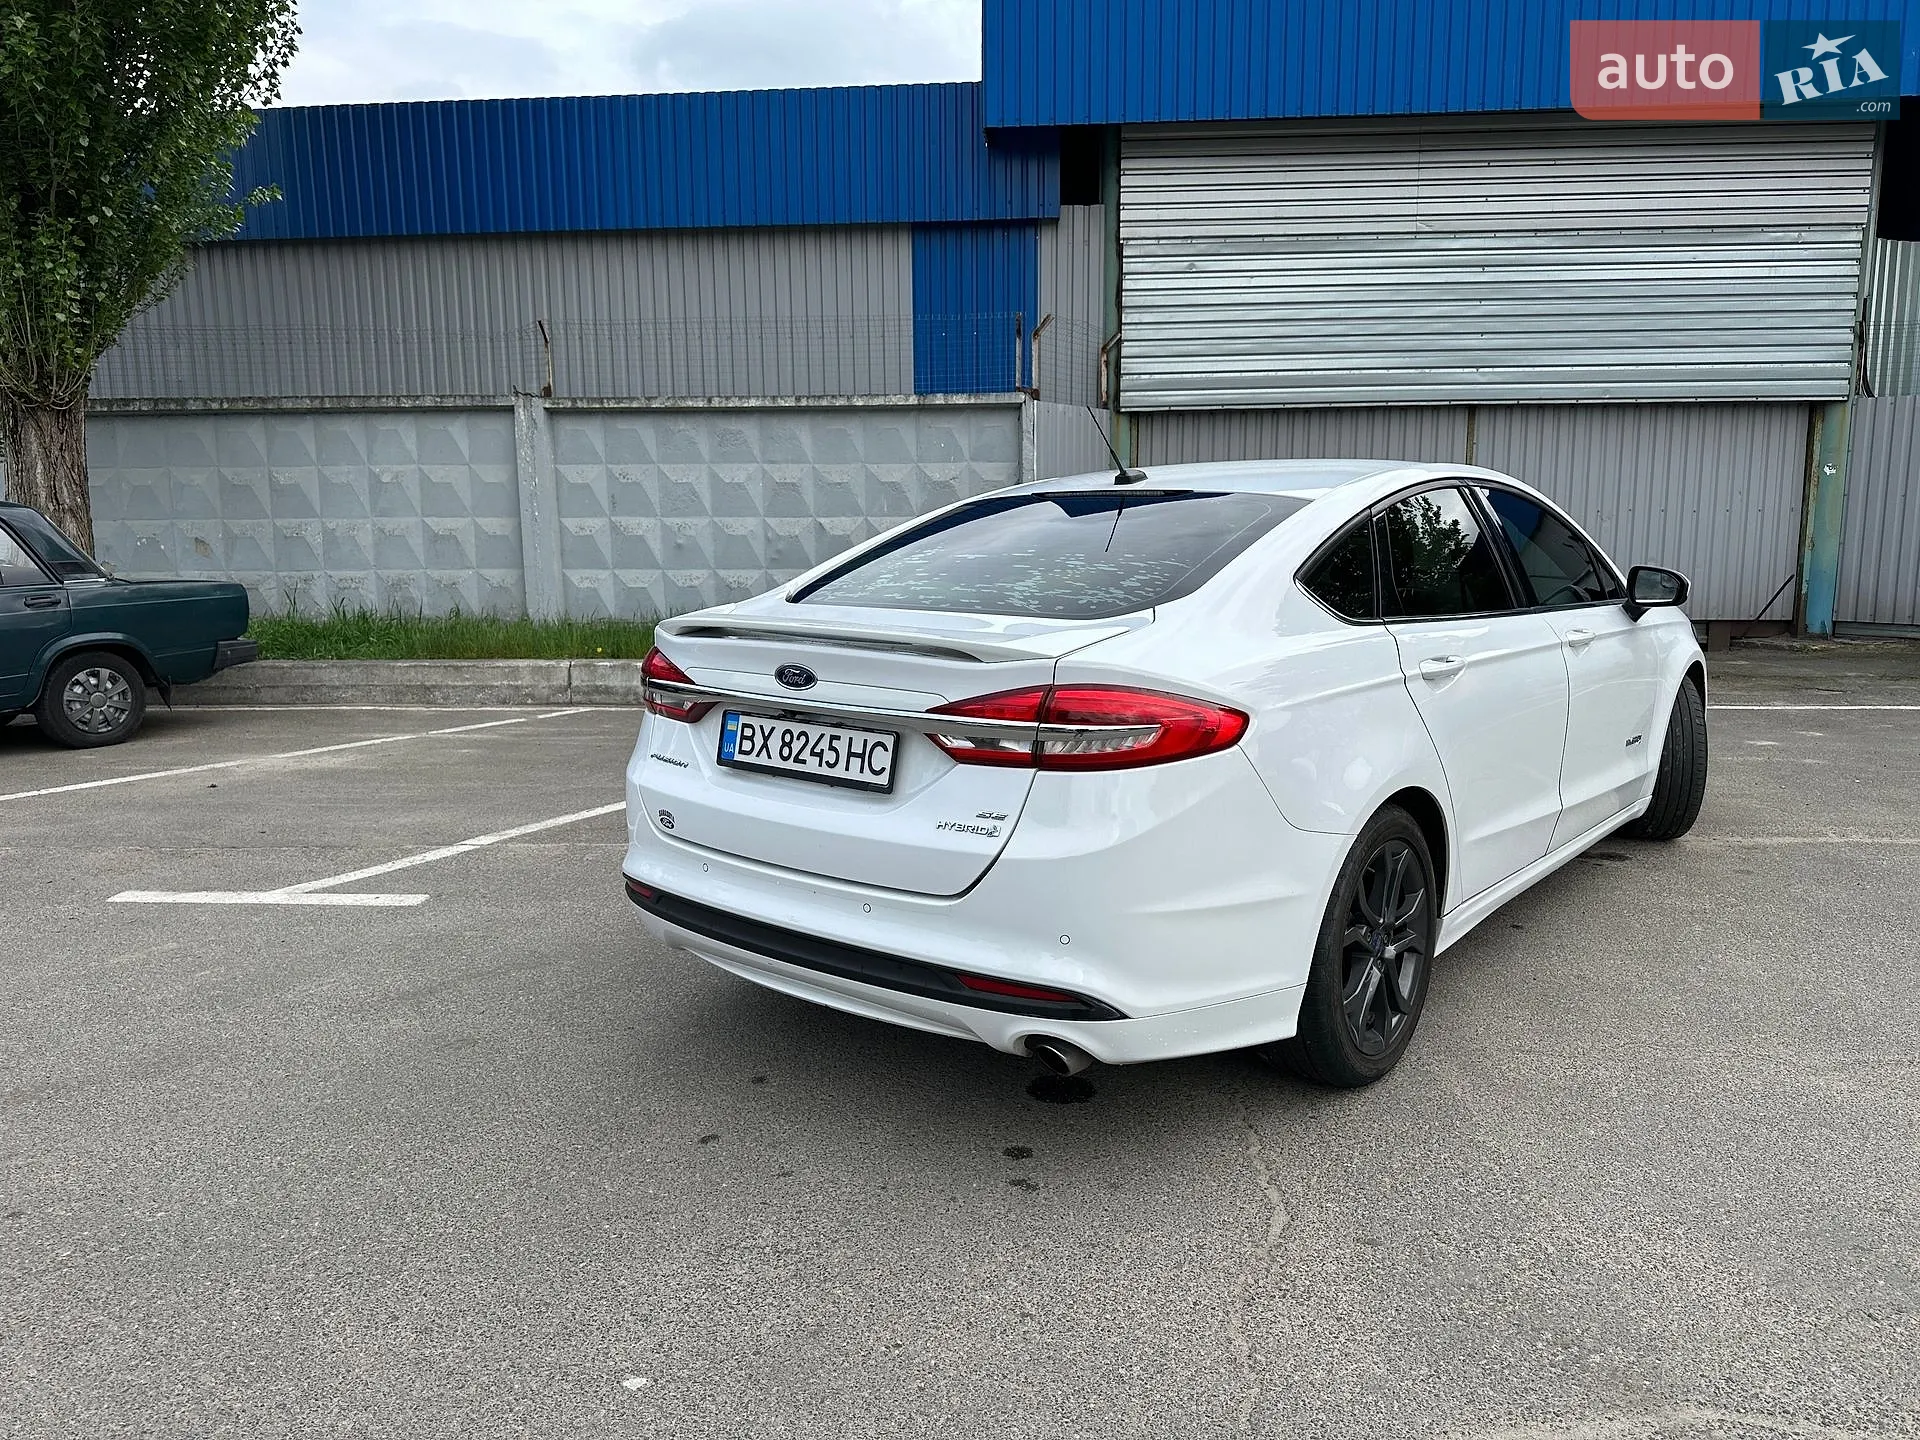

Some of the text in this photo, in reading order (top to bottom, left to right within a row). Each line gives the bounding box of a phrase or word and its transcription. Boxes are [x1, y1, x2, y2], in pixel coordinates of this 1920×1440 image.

[782, 668, 807, 685] Ford
[723, 743, 734, 754] UA
[778, 728, 841, 769] 8245
[936, 821, 989, 836] HYBRID
